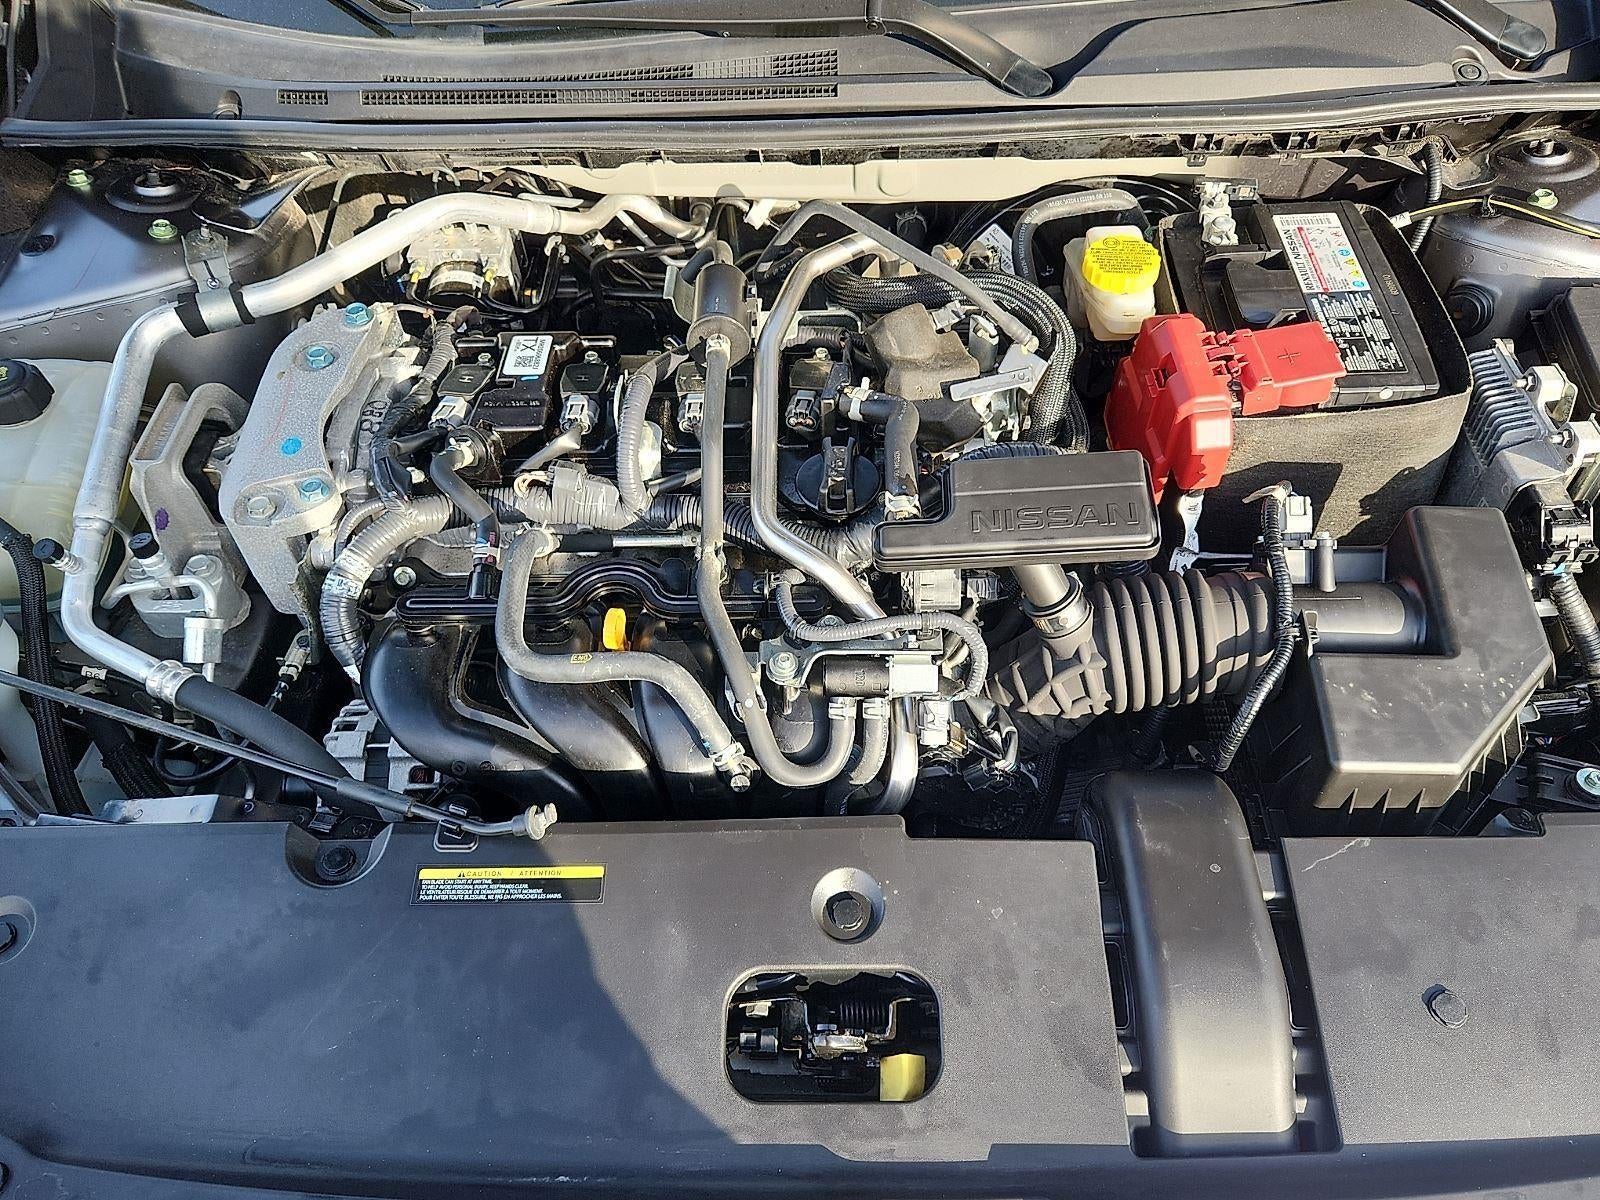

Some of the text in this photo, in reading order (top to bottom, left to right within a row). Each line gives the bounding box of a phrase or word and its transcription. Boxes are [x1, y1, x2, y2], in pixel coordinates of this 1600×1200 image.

[1282, 229, 1303, 260] NISSAN
[1296, 261, 1316, 291] RENAULT
[970, 502, 1141, 534] NISSAN
